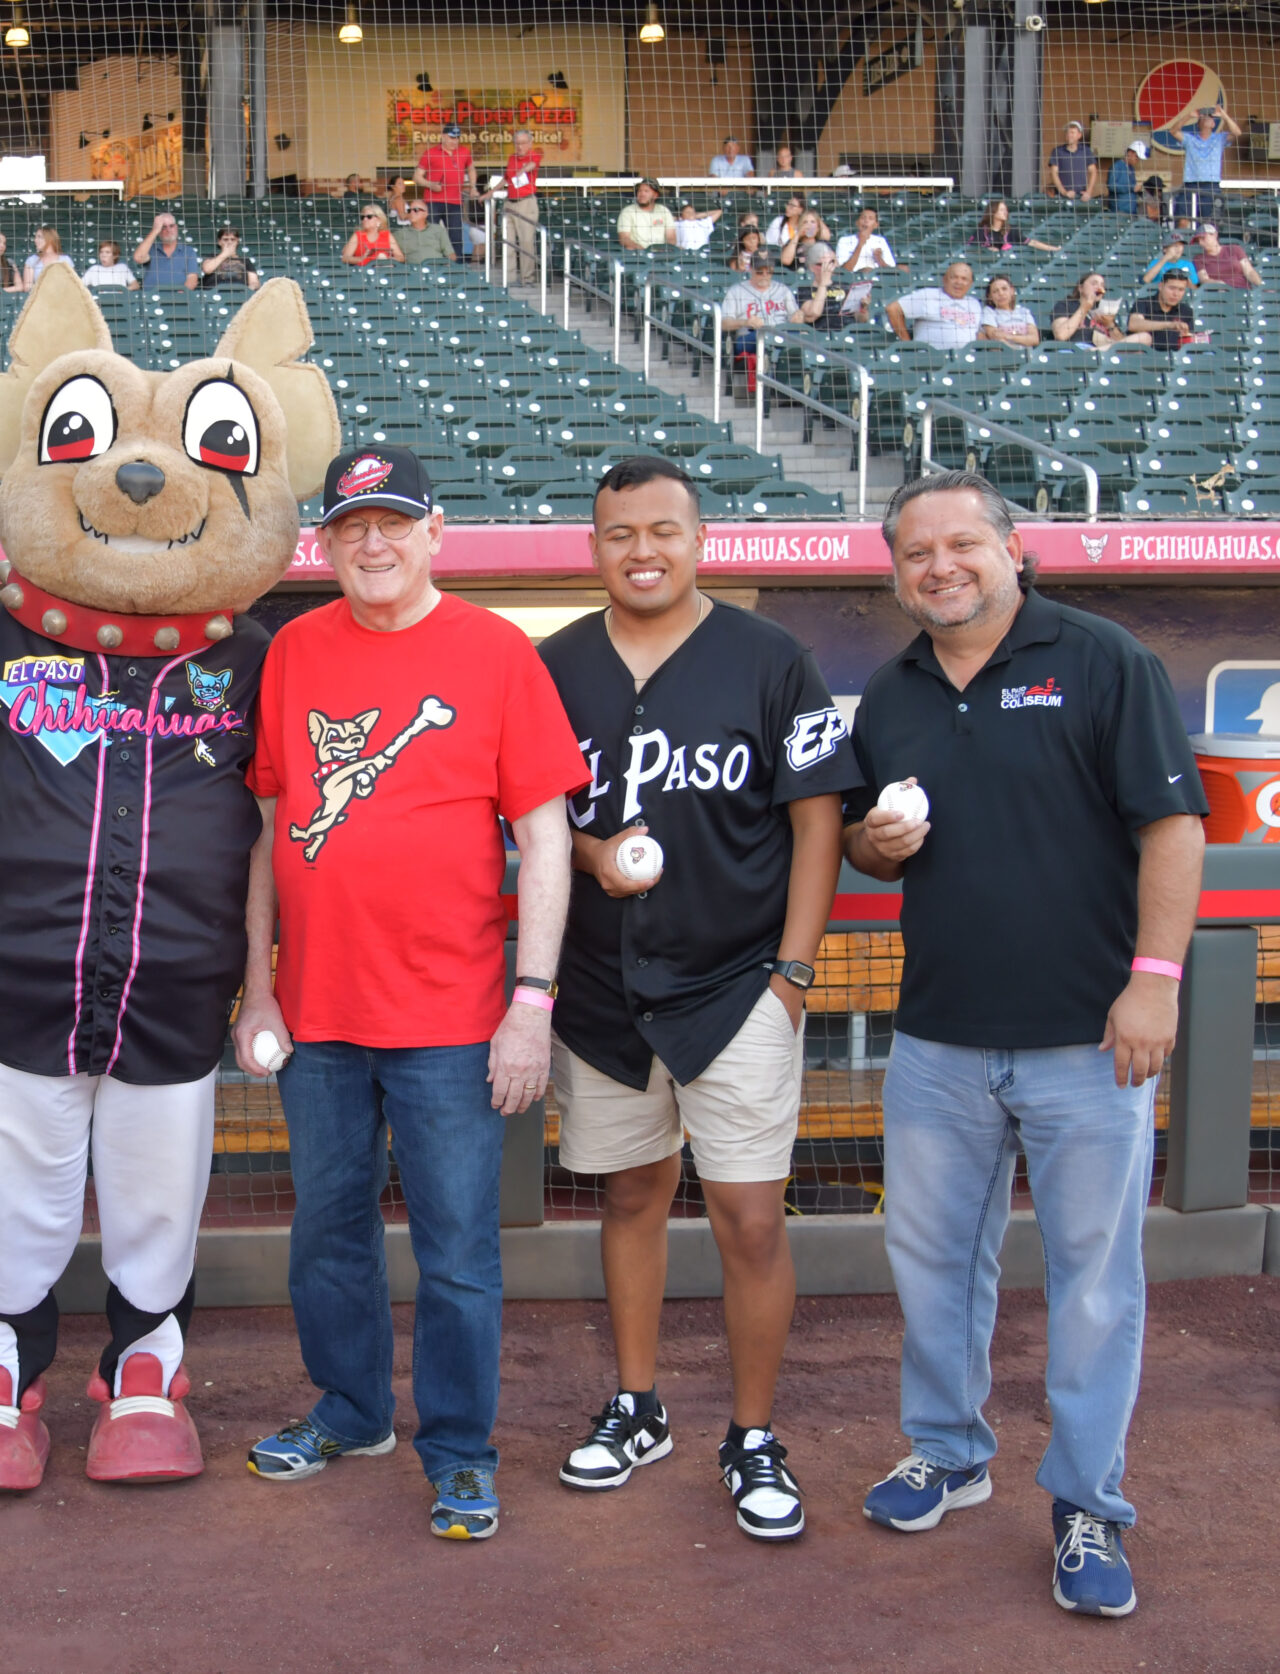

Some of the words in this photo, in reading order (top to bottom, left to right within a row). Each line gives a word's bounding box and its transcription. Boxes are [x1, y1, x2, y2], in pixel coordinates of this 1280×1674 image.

[395, 101, 452, 125] Peter
[456, 101, 514, 127] Piper
[518, 99, 577, 125] Pizza
[413, 131, 477, 144] Everne
[479, 130, 512, 144] Grab
[702, 535, 850, 562] HUAHUAS.COM
[7, 661, 28, 683] EL
[32, 660, 83, 681] PASO
[8, 679, 244, 738] Chihuahuas
[1000, 695, 1062, 709] COLISEUM
[622, 729, 751, 824] PASO
